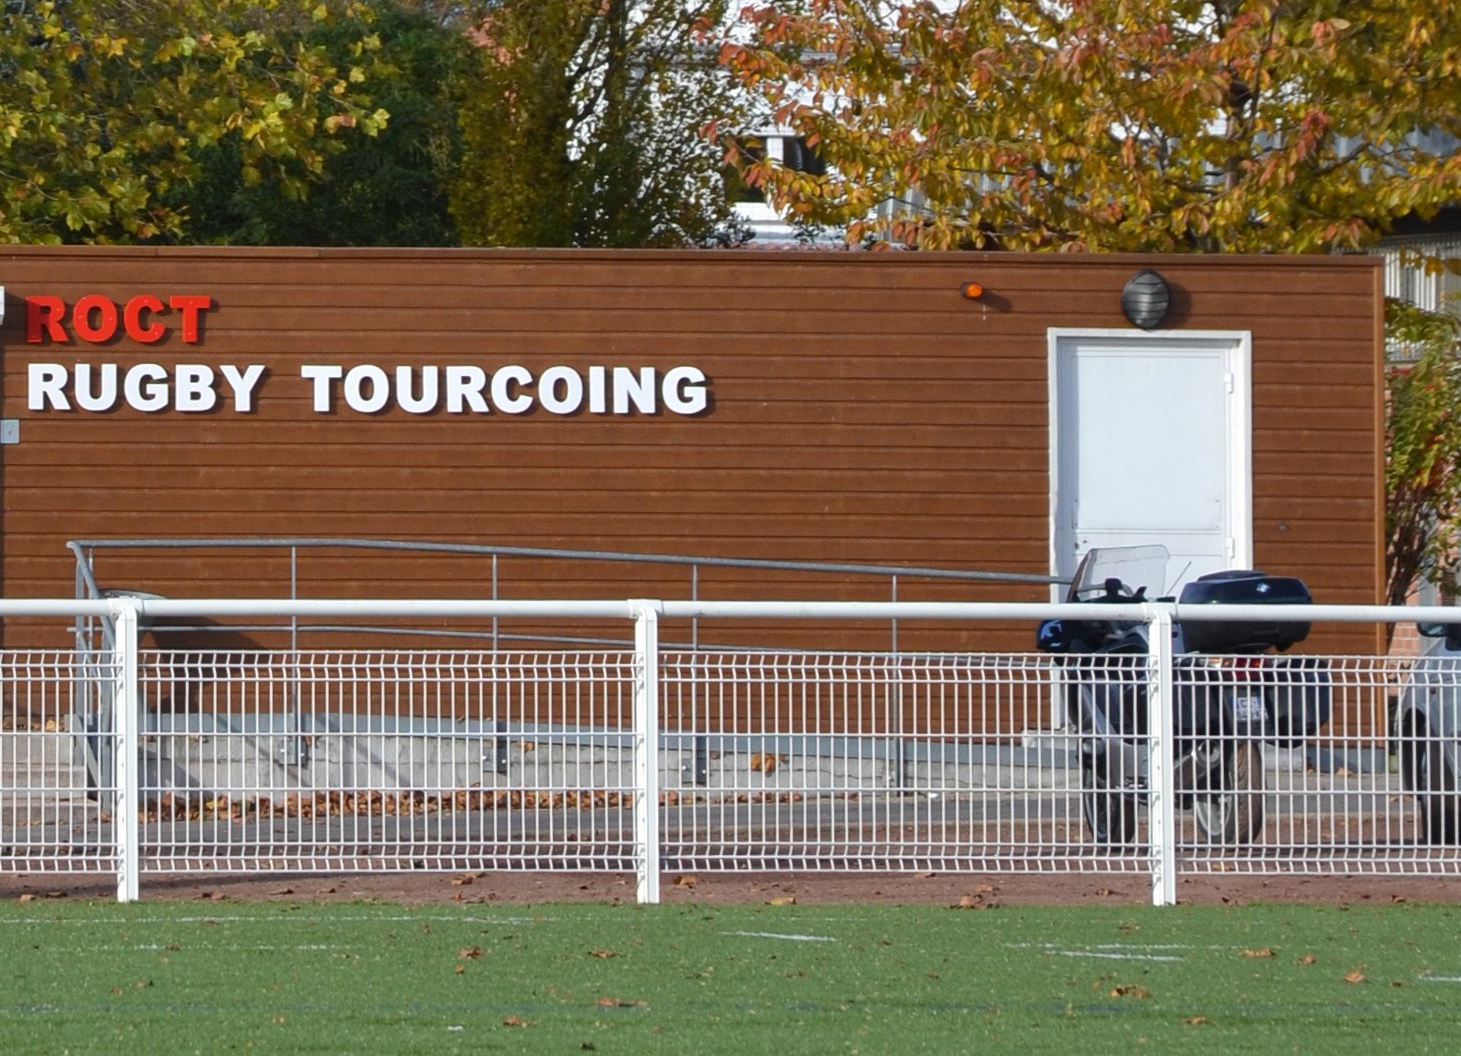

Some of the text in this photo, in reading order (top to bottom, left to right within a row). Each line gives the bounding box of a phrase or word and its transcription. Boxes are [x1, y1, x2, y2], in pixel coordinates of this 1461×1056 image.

[26, 294, 212, 343] ROCT
[27, 363, 707, 414] RUGBY TOURCOING
